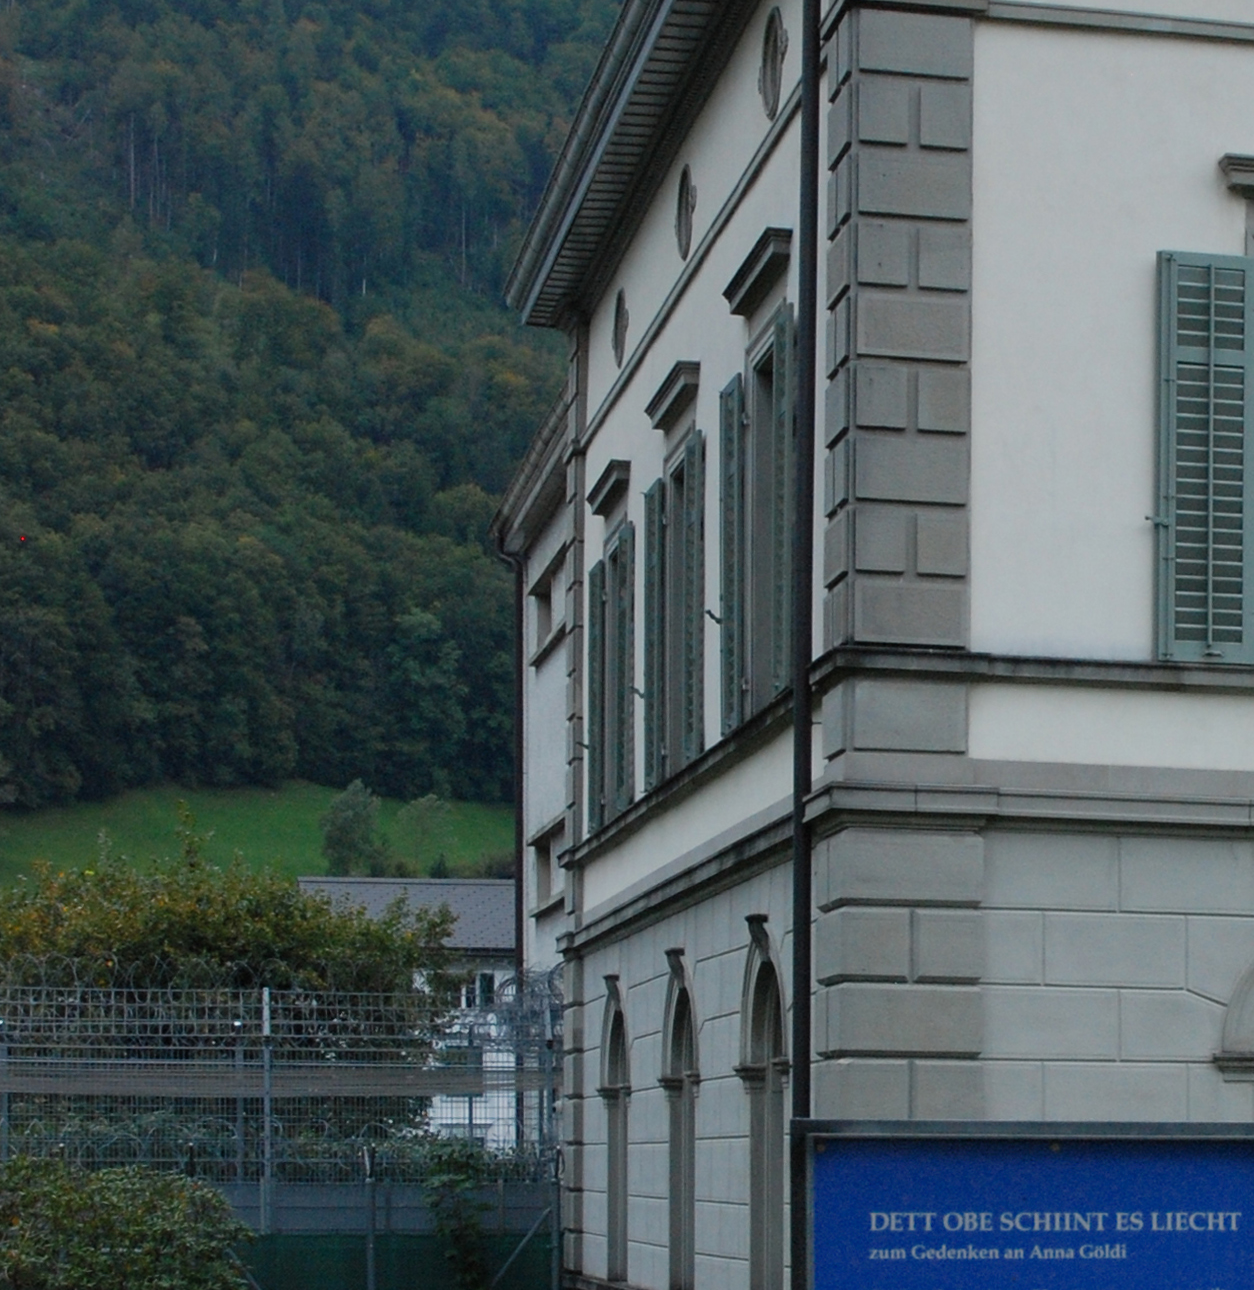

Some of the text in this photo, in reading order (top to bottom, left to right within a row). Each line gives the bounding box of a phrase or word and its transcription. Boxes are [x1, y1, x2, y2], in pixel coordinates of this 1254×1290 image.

[869, 1210, 1243, 1233] DETT OBE SCHIINT ES LIECHT
[868, 1243, 1128, 1261] zum Gedenken an Anna Göldi
